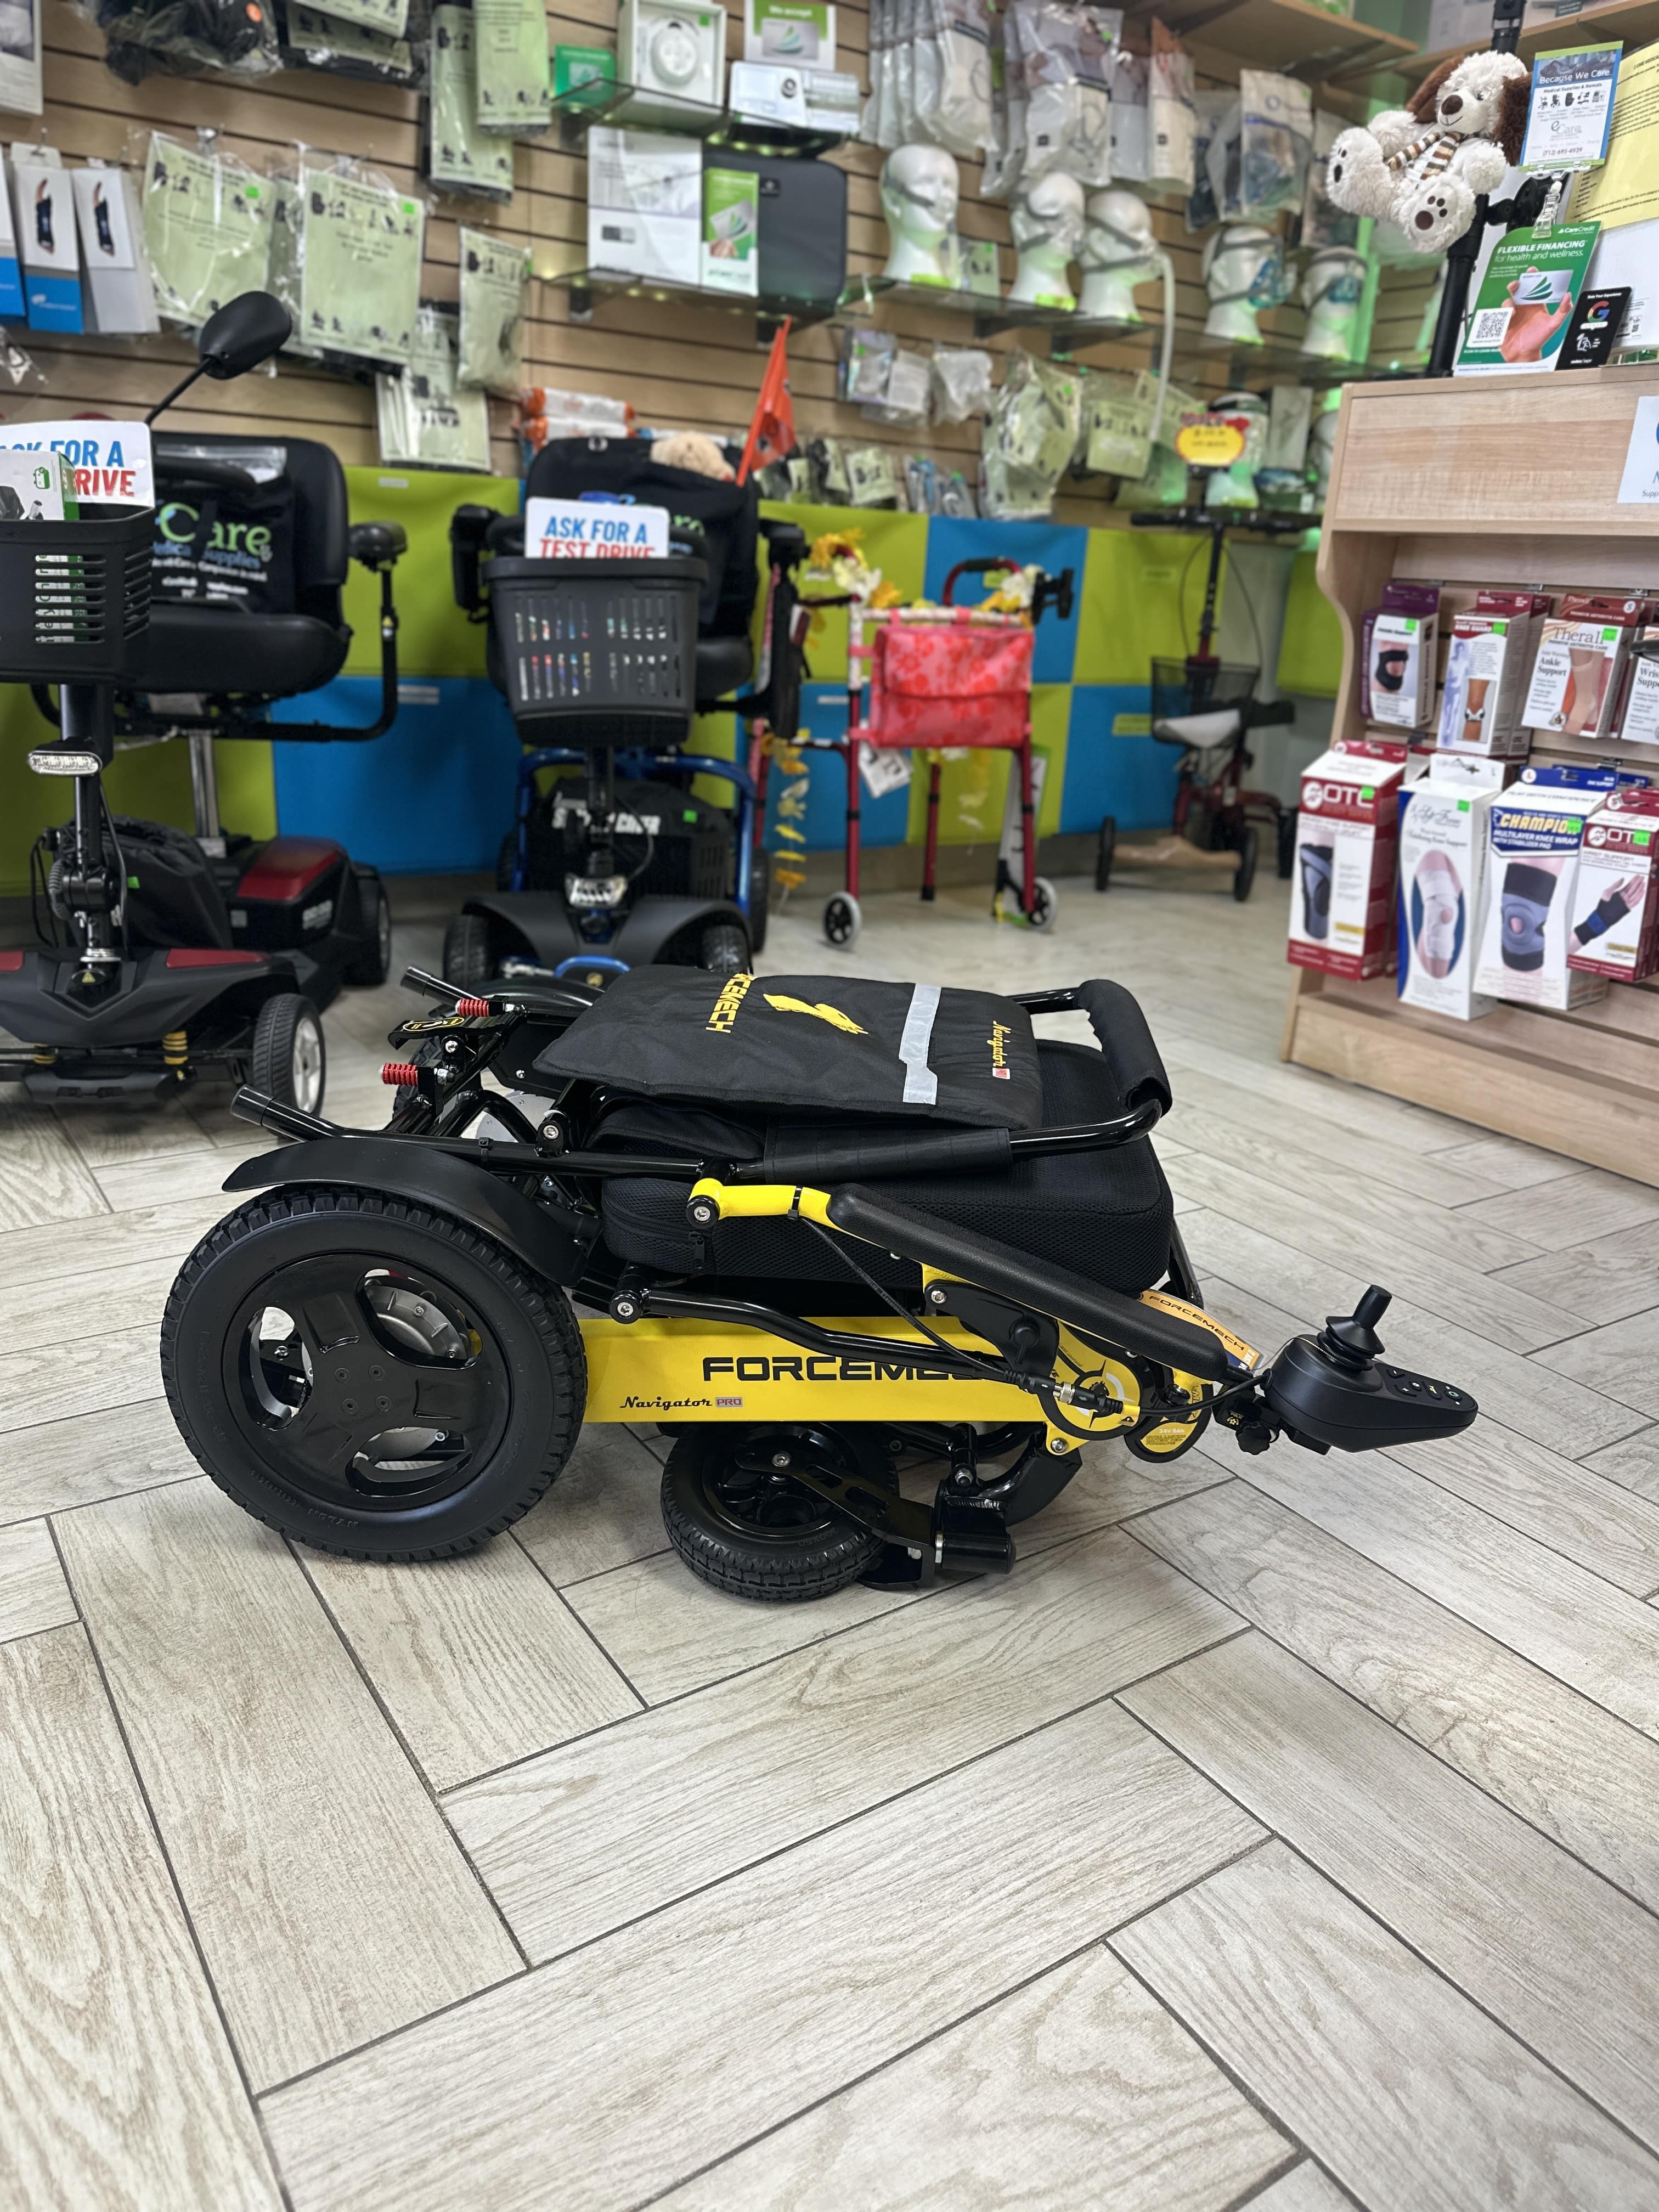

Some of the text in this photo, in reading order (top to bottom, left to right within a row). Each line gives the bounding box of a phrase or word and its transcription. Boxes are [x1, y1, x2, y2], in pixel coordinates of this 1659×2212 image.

[1539, 74, 1573, 84] Because
[1576, 71, 1589, 80] We
[1591, 69, 1610, 77] Care
[1565, 225, 1595, 233] CareCredit
[1494, 249, 1584, 263] for health and wellness.
[1497, 240, 1586, 254] FLEXIBLE FINANCING
[106, 441, 124, 467] A
[75, 469, 136, 496] RIVE
[158, 502, 271, 557] Care
[545, 516, 647, 544] ASK FOR A
[540, 538, 591, 558] TEST
[1537, 665, 1566, 676] Support
[1539, 657, 1561, 667] Ankle
[1640, 667, 1659, 679] Wris
[1323, 783, 1374, 809] OTC
[1499, 813, 1578, 835] CHAMPIO
[1493, 829, 1578, 845] MULTILAYER KNEE WRAP
[1607, 828, 1650, 846] OT
[986, 1020, 1012, 1067] Navigator
[1149, 1295, 1245, 1351] FORCEMECH
[702, 1356, 983, 1381] FORCEME
[620, 1396, 742, 1410] Navigator PRO
